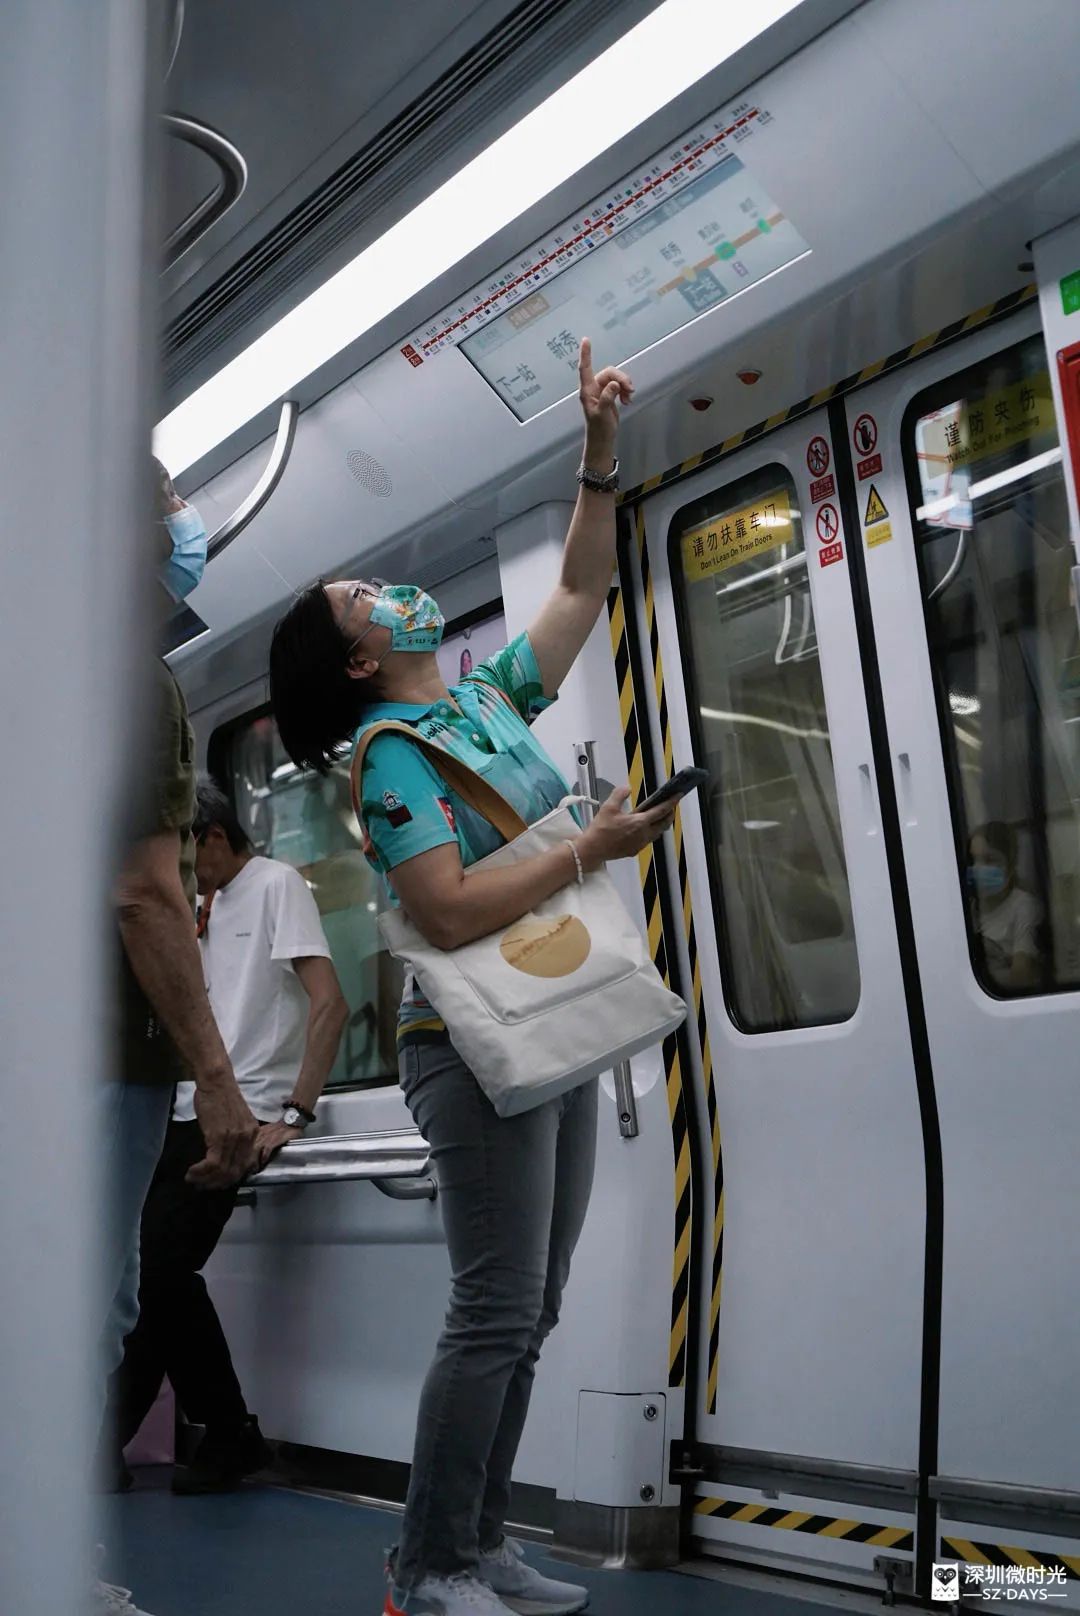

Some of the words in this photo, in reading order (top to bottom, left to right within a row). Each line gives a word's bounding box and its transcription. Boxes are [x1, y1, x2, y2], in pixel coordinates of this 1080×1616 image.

[546, 329, 580, 360] 新秀
[495, 363, 537, 394] 下一站
[944, 386, 1036, 447] 谨防夹伤
[693, 504, 776, 557] 请勿扶靠车门
[717, 552, 730, 564] Lean
[739, 541, 754, 553] Train
[754, 533, 773, 545] Doors
